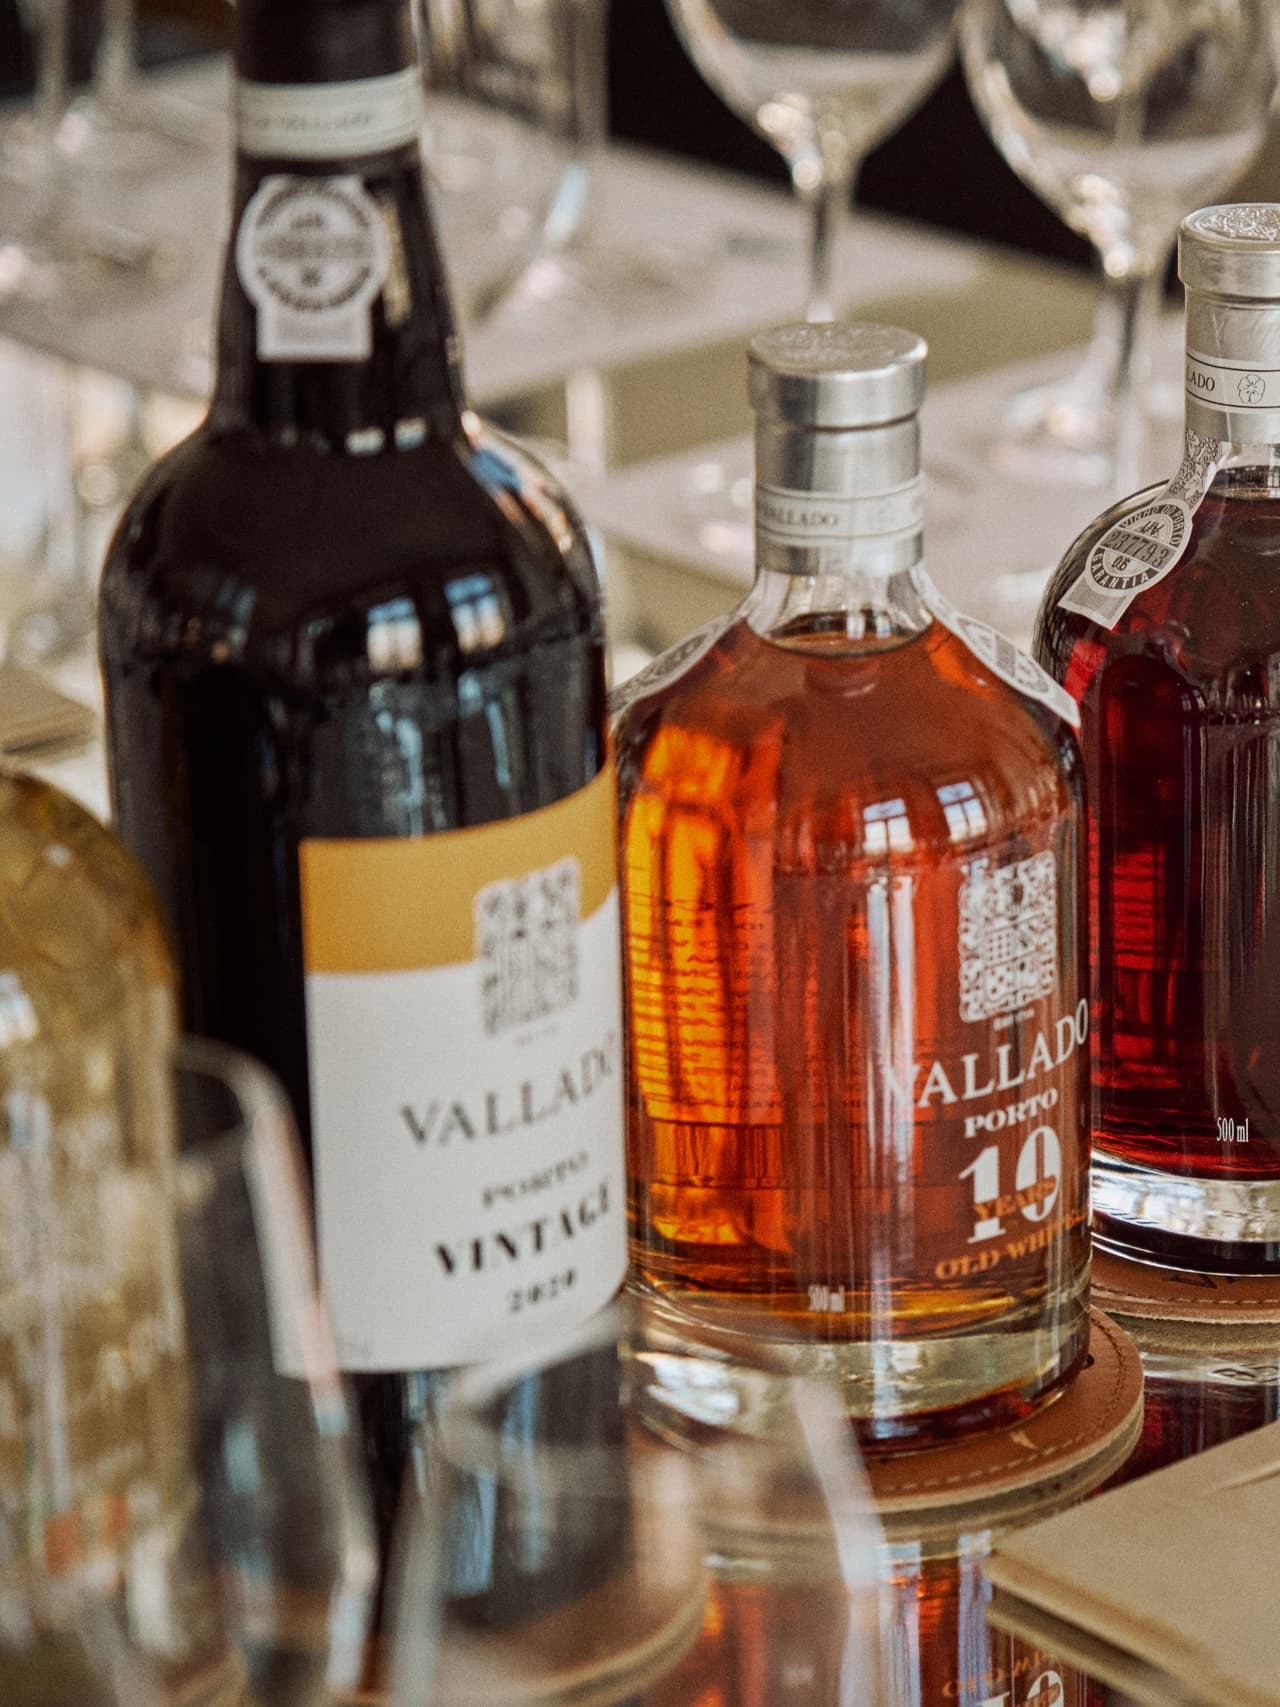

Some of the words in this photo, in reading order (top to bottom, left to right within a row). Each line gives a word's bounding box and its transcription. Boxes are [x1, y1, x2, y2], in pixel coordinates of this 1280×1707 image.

[1092, 553, 1150, 589] GARANTIA
[884, 997, 1088, 1108] VALLADO
[401, 1028, 618, 1146] VALLAD
[965, 1087, 1059, 1139] PORTO
[1216, 1116, 1235, 1142] 500
[1236, 1117, 1249, 1143] ml
[958, 1125, 1063, 1244] 10
[974, 1174, 1057, 1222] YEARS
[934, 1249, 1000, 1281] OLD
